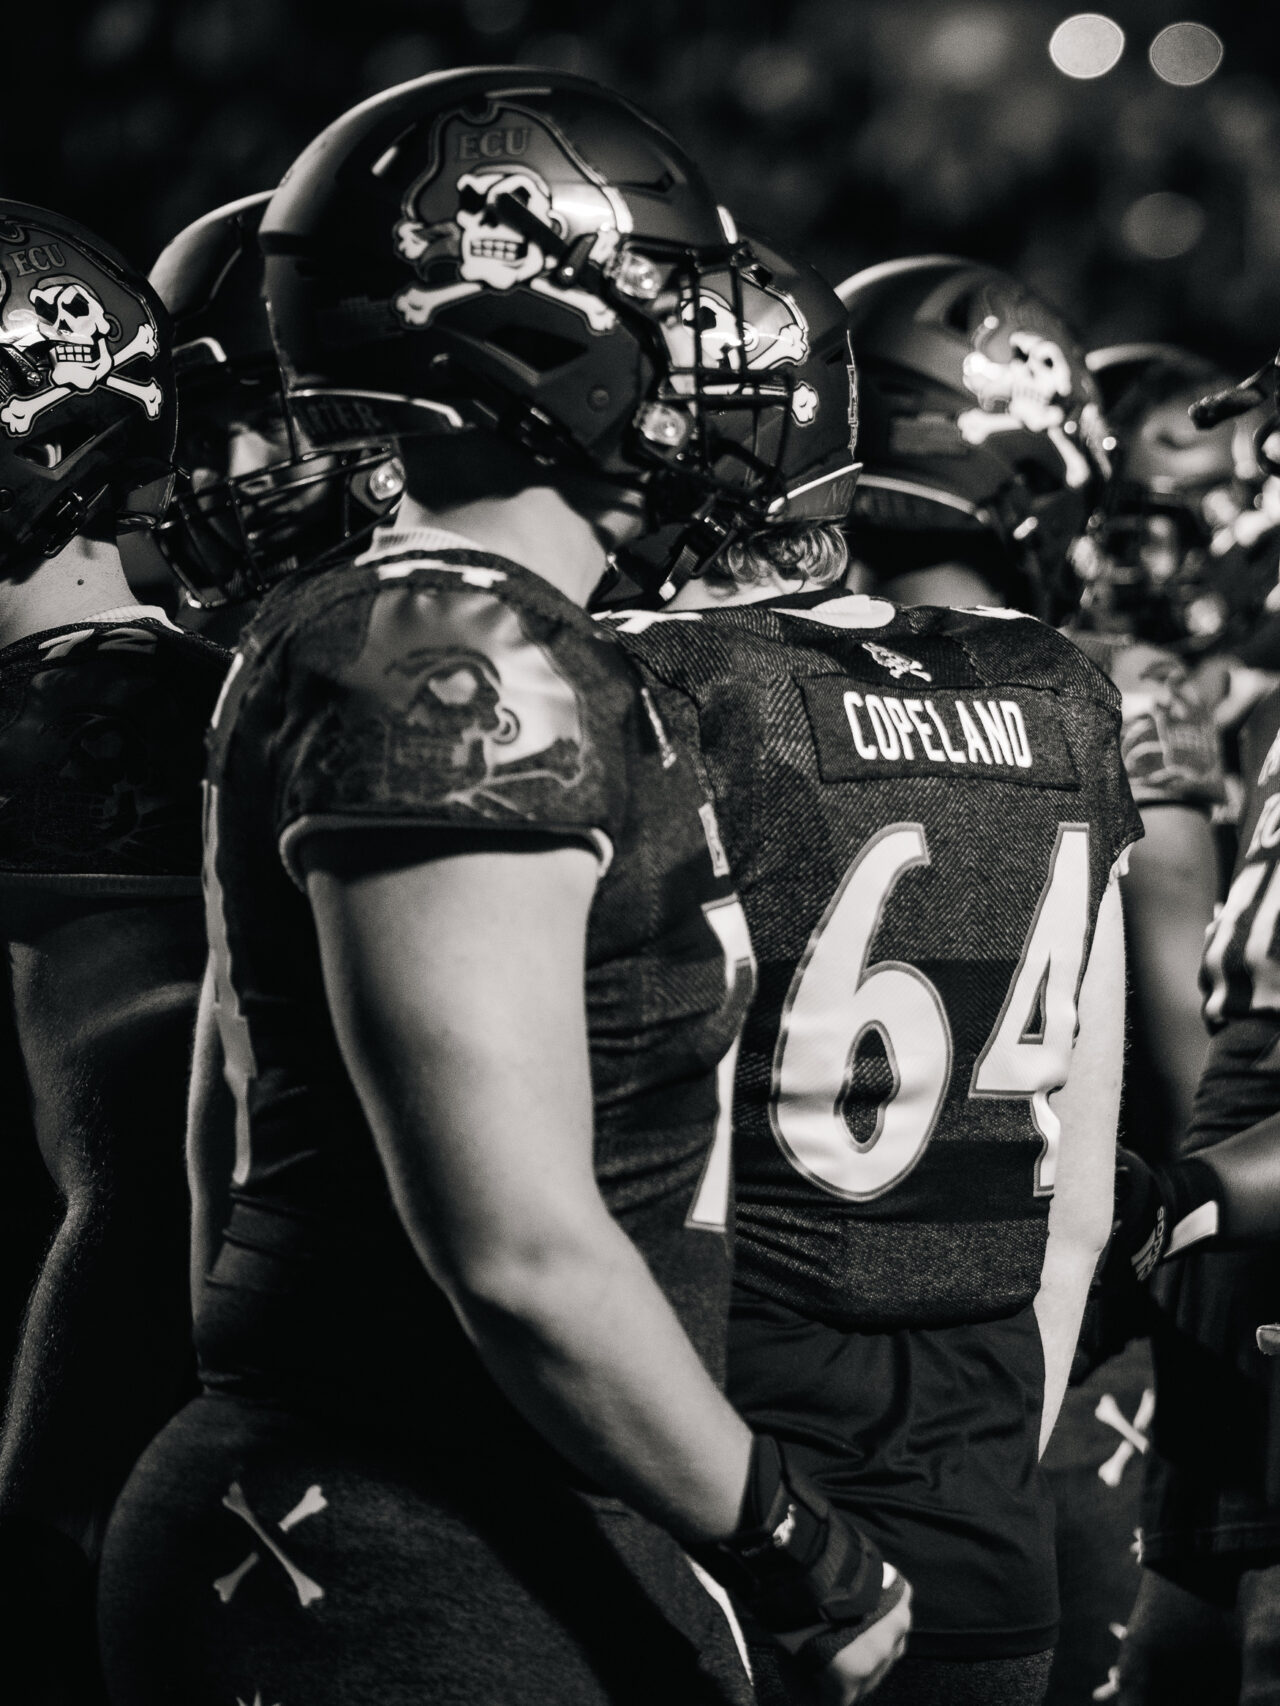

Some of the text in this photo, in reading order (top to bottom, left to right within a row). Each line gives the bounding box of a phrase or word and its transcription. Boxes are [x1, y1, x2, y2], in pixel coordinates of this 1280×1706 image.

[459, 129, 528, 160] ECU
[8, 243, 66, 277] ECU
[843, 691, 1032, 768] COPELAND
[769, 821, 1089, 1200] 64
